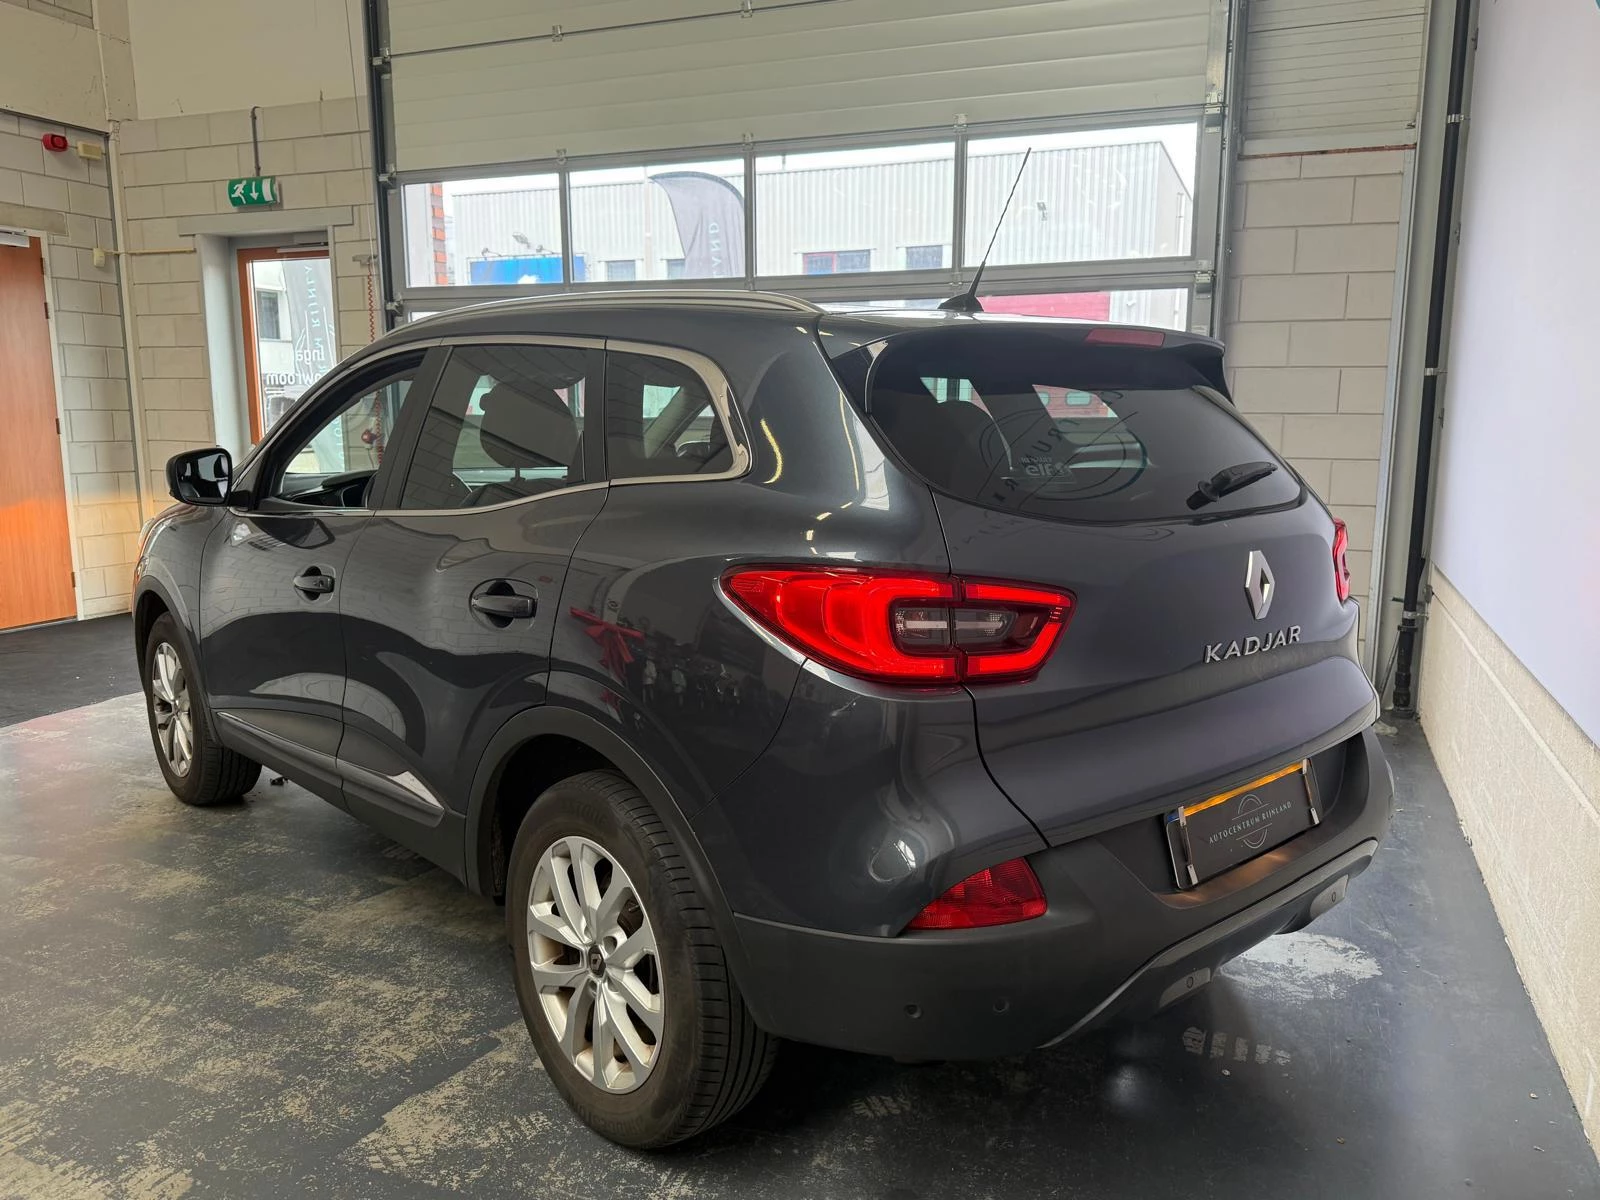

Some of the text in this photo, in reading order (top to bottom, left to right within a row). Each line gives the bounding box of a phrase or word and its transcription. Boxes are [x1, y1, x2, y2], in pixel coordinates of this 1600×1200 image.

[1204, 625, 1301, 663] KADJAR
[1209, 800, 1292, 844] AUTOCENTRUM RIJNLAND
